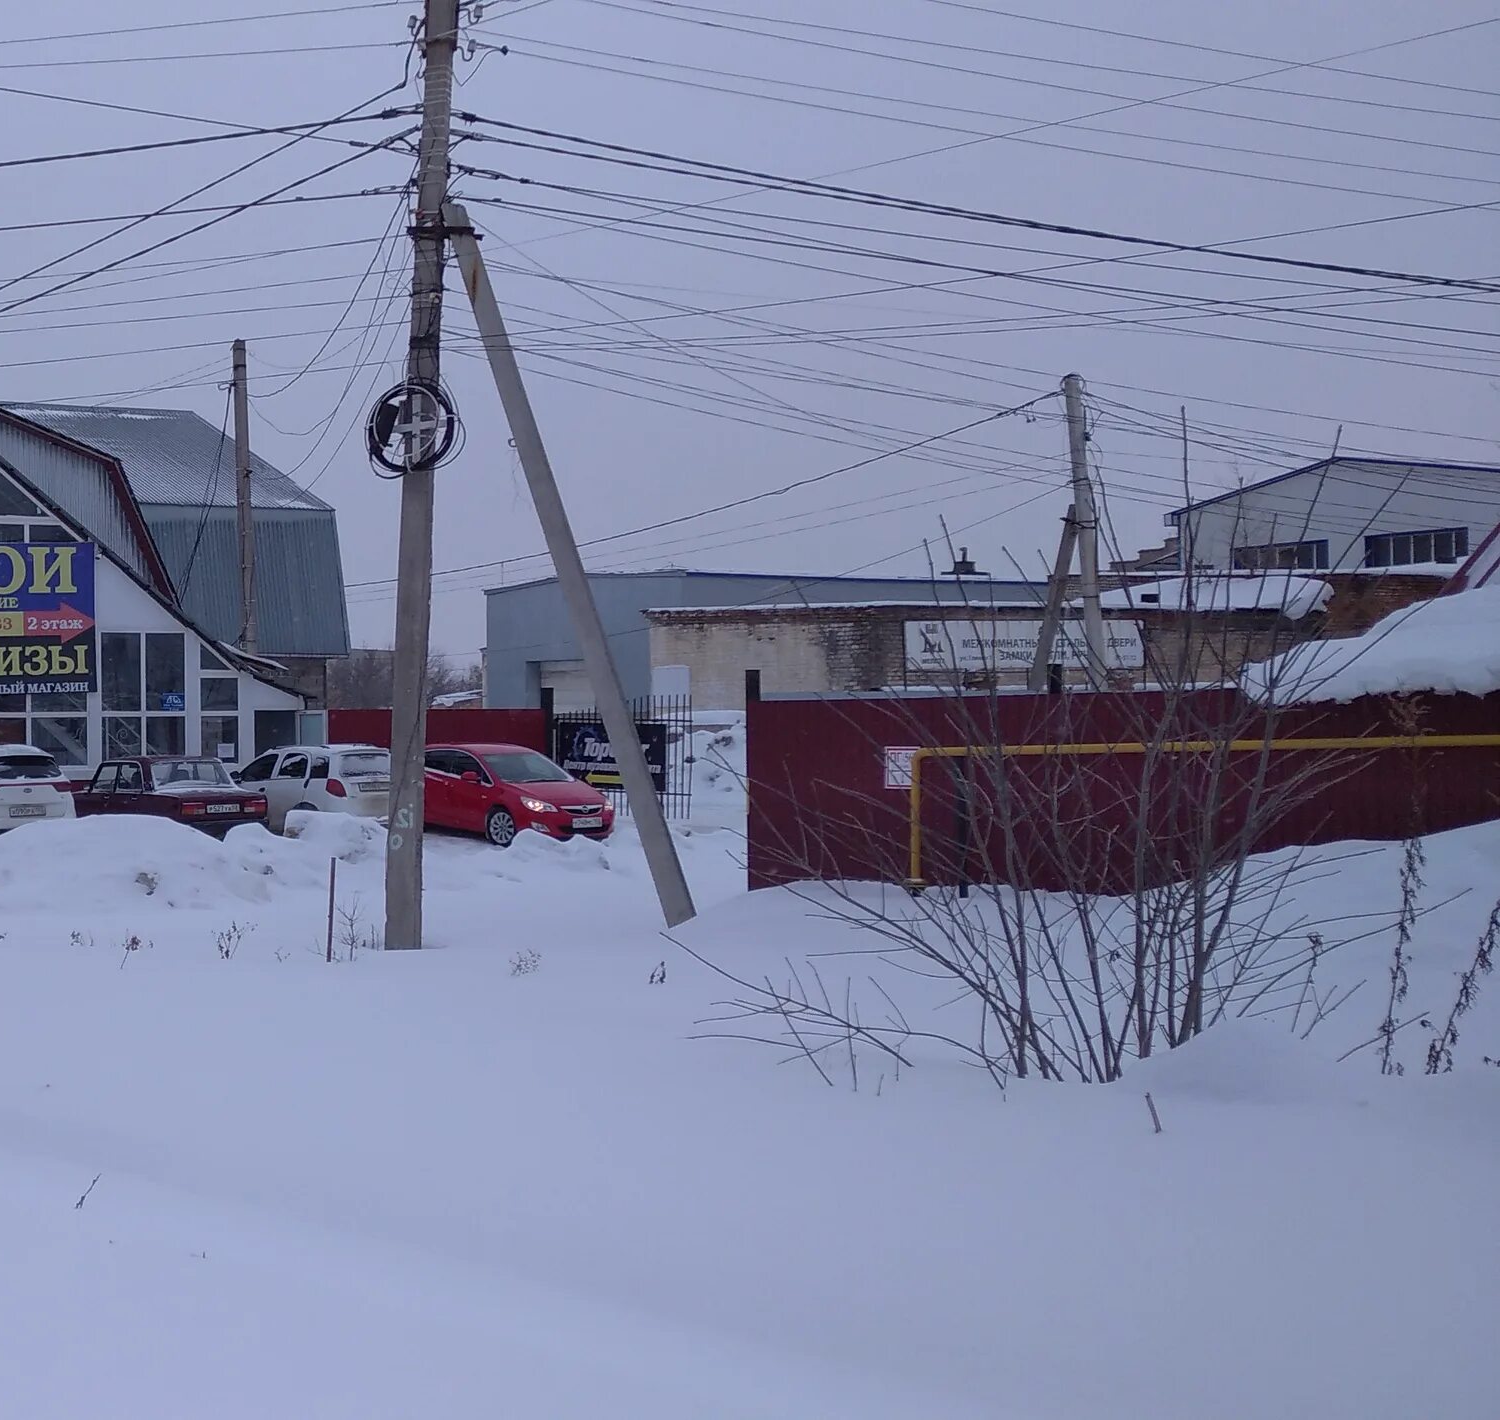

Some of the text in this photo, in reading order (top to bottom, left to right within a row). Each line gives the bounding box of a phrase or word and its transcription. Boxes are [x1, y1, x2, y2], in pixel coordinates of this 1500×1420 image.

[28, 617, 84, 631] 2 этаж
[27, 682, 89, 694] МАГАЗИН
